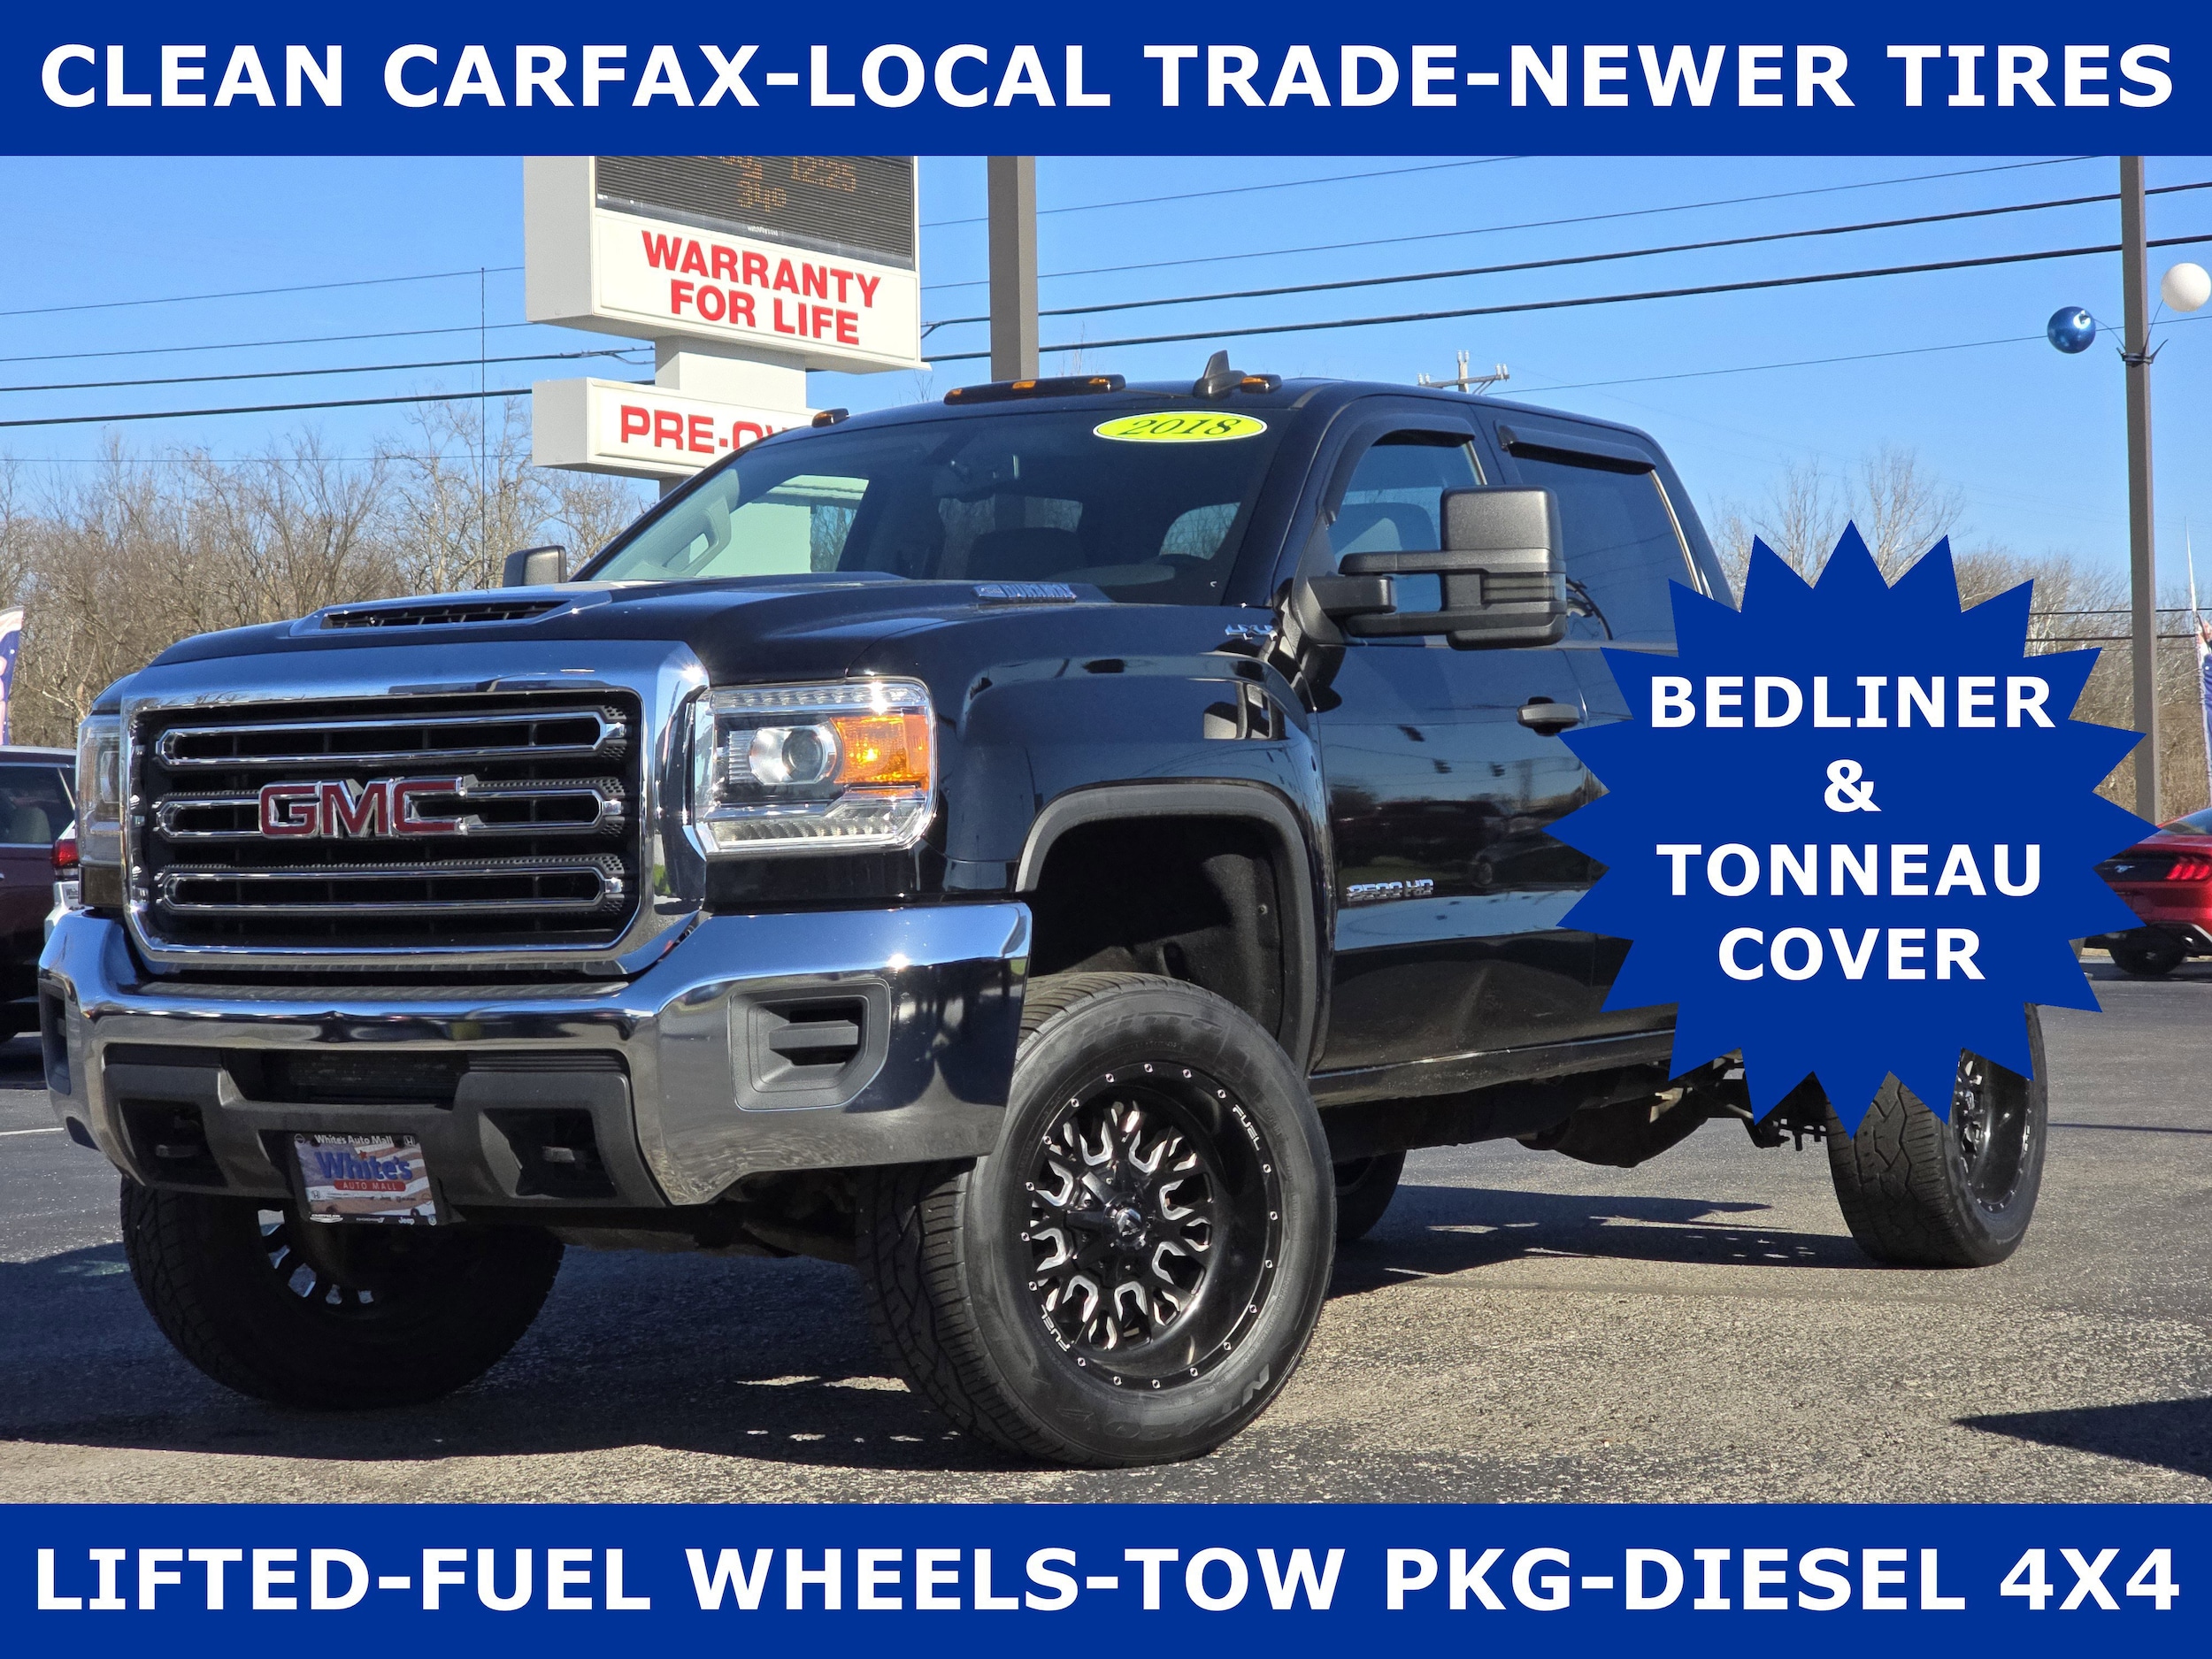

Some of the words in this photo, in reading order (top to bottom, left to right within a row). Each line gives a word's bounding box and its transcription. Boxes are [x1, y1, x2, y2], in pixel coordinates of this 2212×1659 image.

[641, 230, 881, 309] WARRANTY
[671, 279, 757, 327] FOR
[773, 297, 860, 346] LIFE
[620, 404, 787, 454] PRE-O
[1118, 419, 1242, 435] 2018
[259, 777, 467, 839] GMC
[314, 1134, 347, 1145] White's
[348, 1135, 370, 1145] Auto
[371, 1135, 394, 1145] Mall
[1232, 1104, 1260, 1151] FUEL
[314, 1150, 413, 1180] White's
[342, 1181, 367, 1190] AUTO
[373, 1181, 397, 1191] MALL
[1041, 1304, 1071, 1352] FUEL
